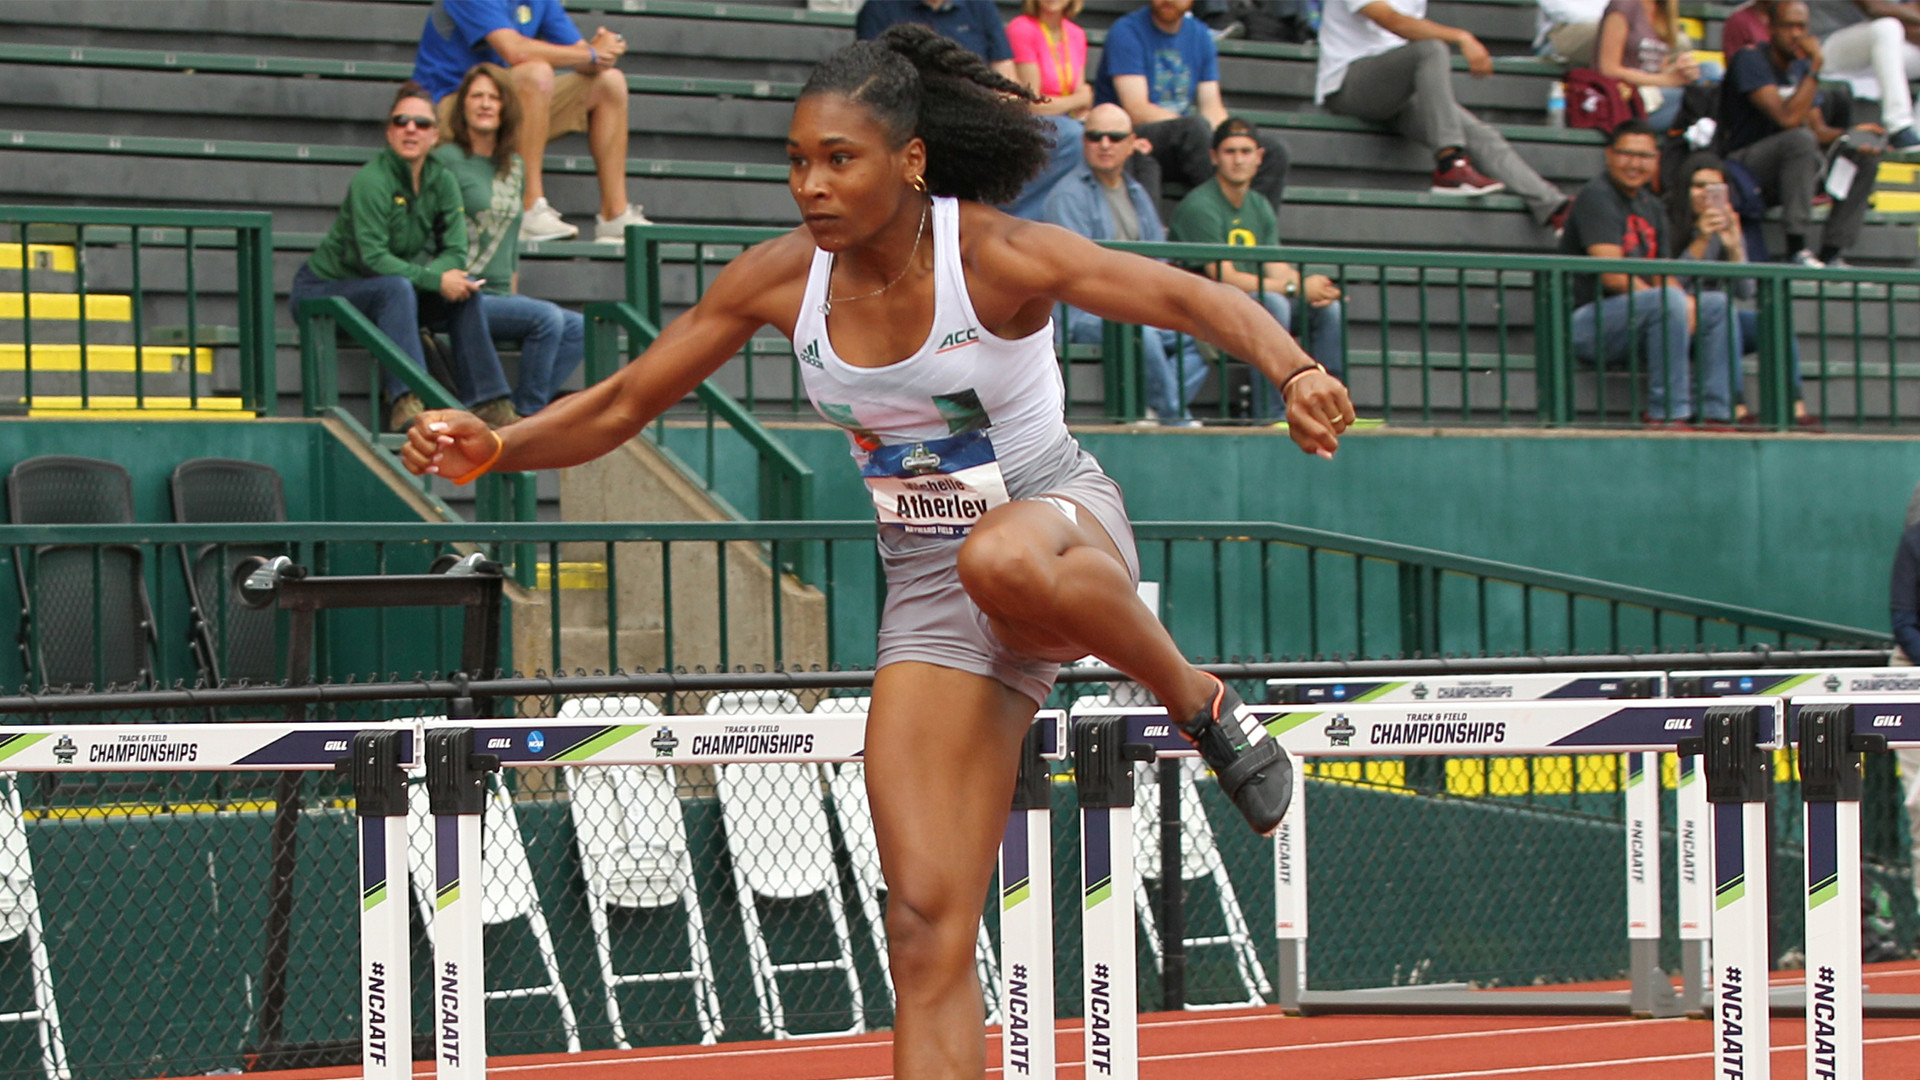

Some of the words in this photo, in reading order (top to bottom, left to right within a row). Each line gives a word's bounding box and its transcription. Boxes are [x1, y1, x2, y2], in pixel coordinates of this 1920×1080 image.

[939, 327, 979, 350] ACC
[897, 494, 988, 519] Atherley
[1406, 713, 1433, 722] TRACK
[1443, 712, 1467, 721] FIELD
[1663, 718, 1693, 730] GILL
[1872, 715, 1902, 727] GILL
[118, 735, 140, 743] TRACK
[148, 734, 167, 742] FIELD
[724, 725, 748, 734] TRACK
[757, 724, 779, 733] FIELD
[1143, 725, 1169, 737] GILL
[1370, 722, 1506, 745] CHAMPIONSHIPS
[89, 743, 198, 763] CHAMPIONSHIPS
[324, 740, 348, 751] GILL
[487, 738, 511, 749] GILL
[692, 733, 814, 756] CHAMPIONSHIPS
[368, 961, 386, 1068] #NCAATF
[441, 961, 460, 1068] #NCAATF
[1009, 963, 1030, 1076] #NCAATF
[1091, 963, 1111, 1076] #NCAATF
[1721, 966, 1744, 1080] #NCAATF
[1814, 966, 1836, 1080] #NCAATF
